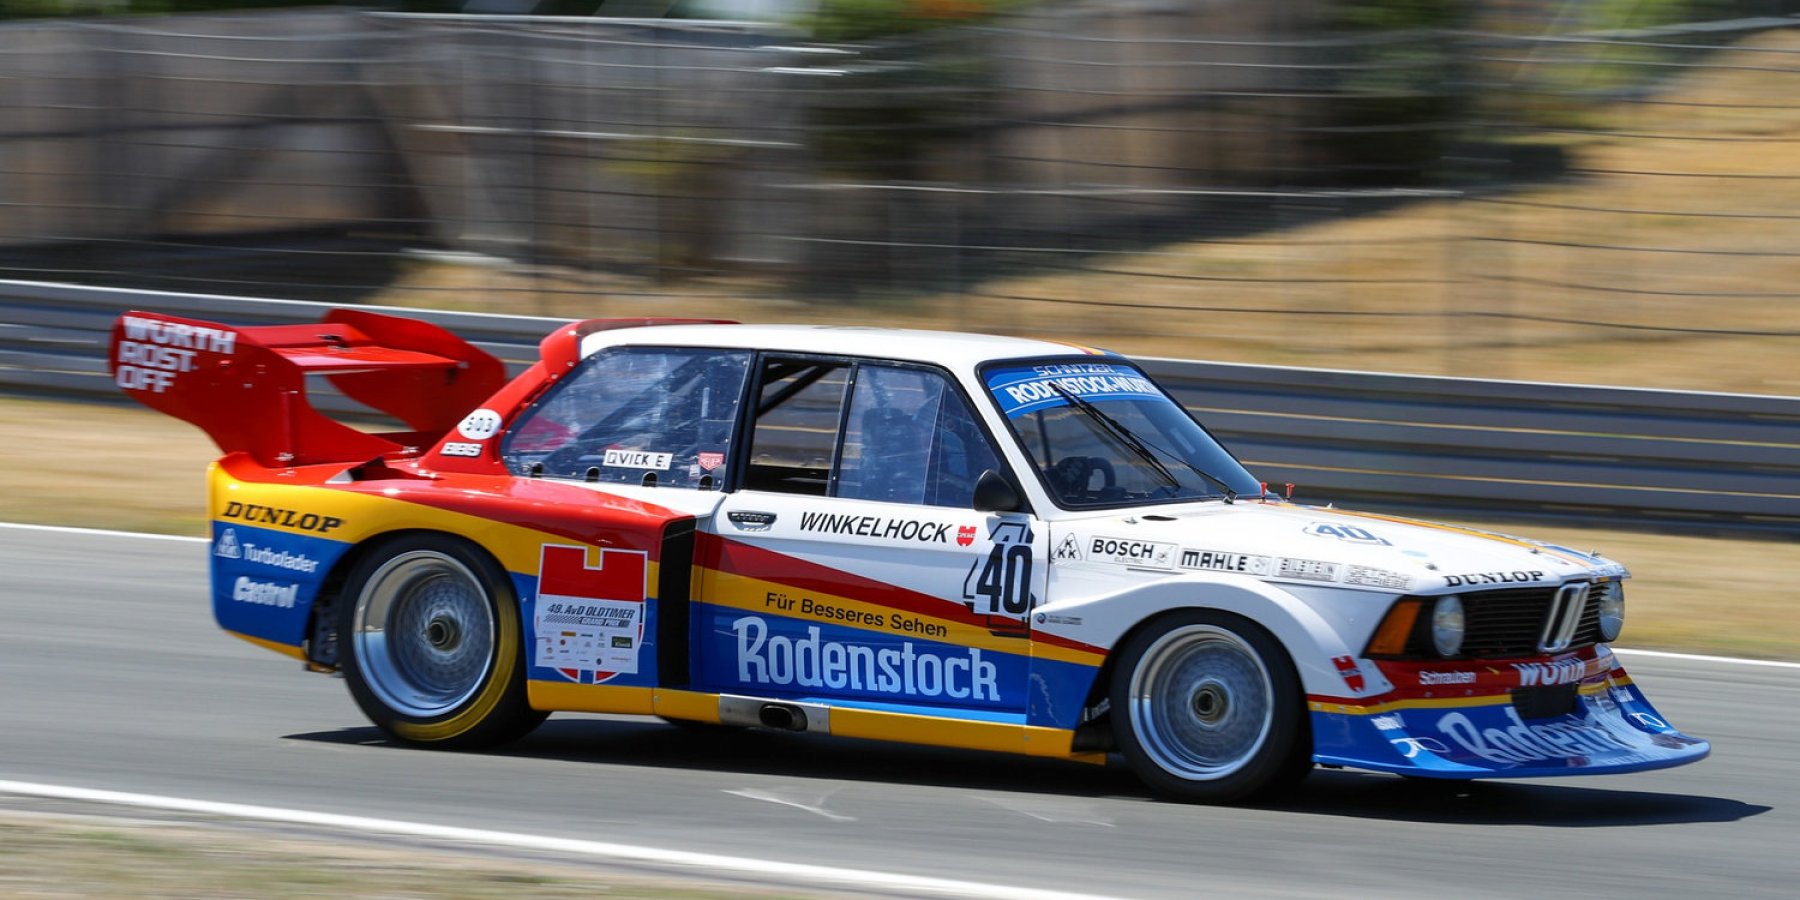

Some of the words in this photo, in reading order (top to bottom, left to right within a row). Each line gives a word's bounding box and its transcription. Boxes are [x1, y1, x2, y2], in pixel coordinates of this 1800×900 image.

[116, 365, 177, 393] OFF
[1033, 364, 1115, 377] SCHNITZER
[439, 442, 482, 457] BBS
[223, 501, 345, 533] DUNLOP
[799, 511, 953, 543] WINKELHOCK
[242, 543, 319, 573] Turbolader
[1092, 538, 1154, 559] BOSCH
[1181, 550, 1248, 571] MAHLE
[233, 576, 299, 608] Castrol
[976, 543, 1033, 615] 40
[1442, 571, 1545, 587] DUNLOP
[547, 604, 563, 614] 49.
[563, 605, 585, 616] AvD
[585, 606, 636, 619] OLDTIMER
[765, 592, 796, 611] Für
[801, 598, 884, 627] Besseres
[890, 614, 948, 637] Sehen
[732, 616, 1001, 701] Rodenstock
